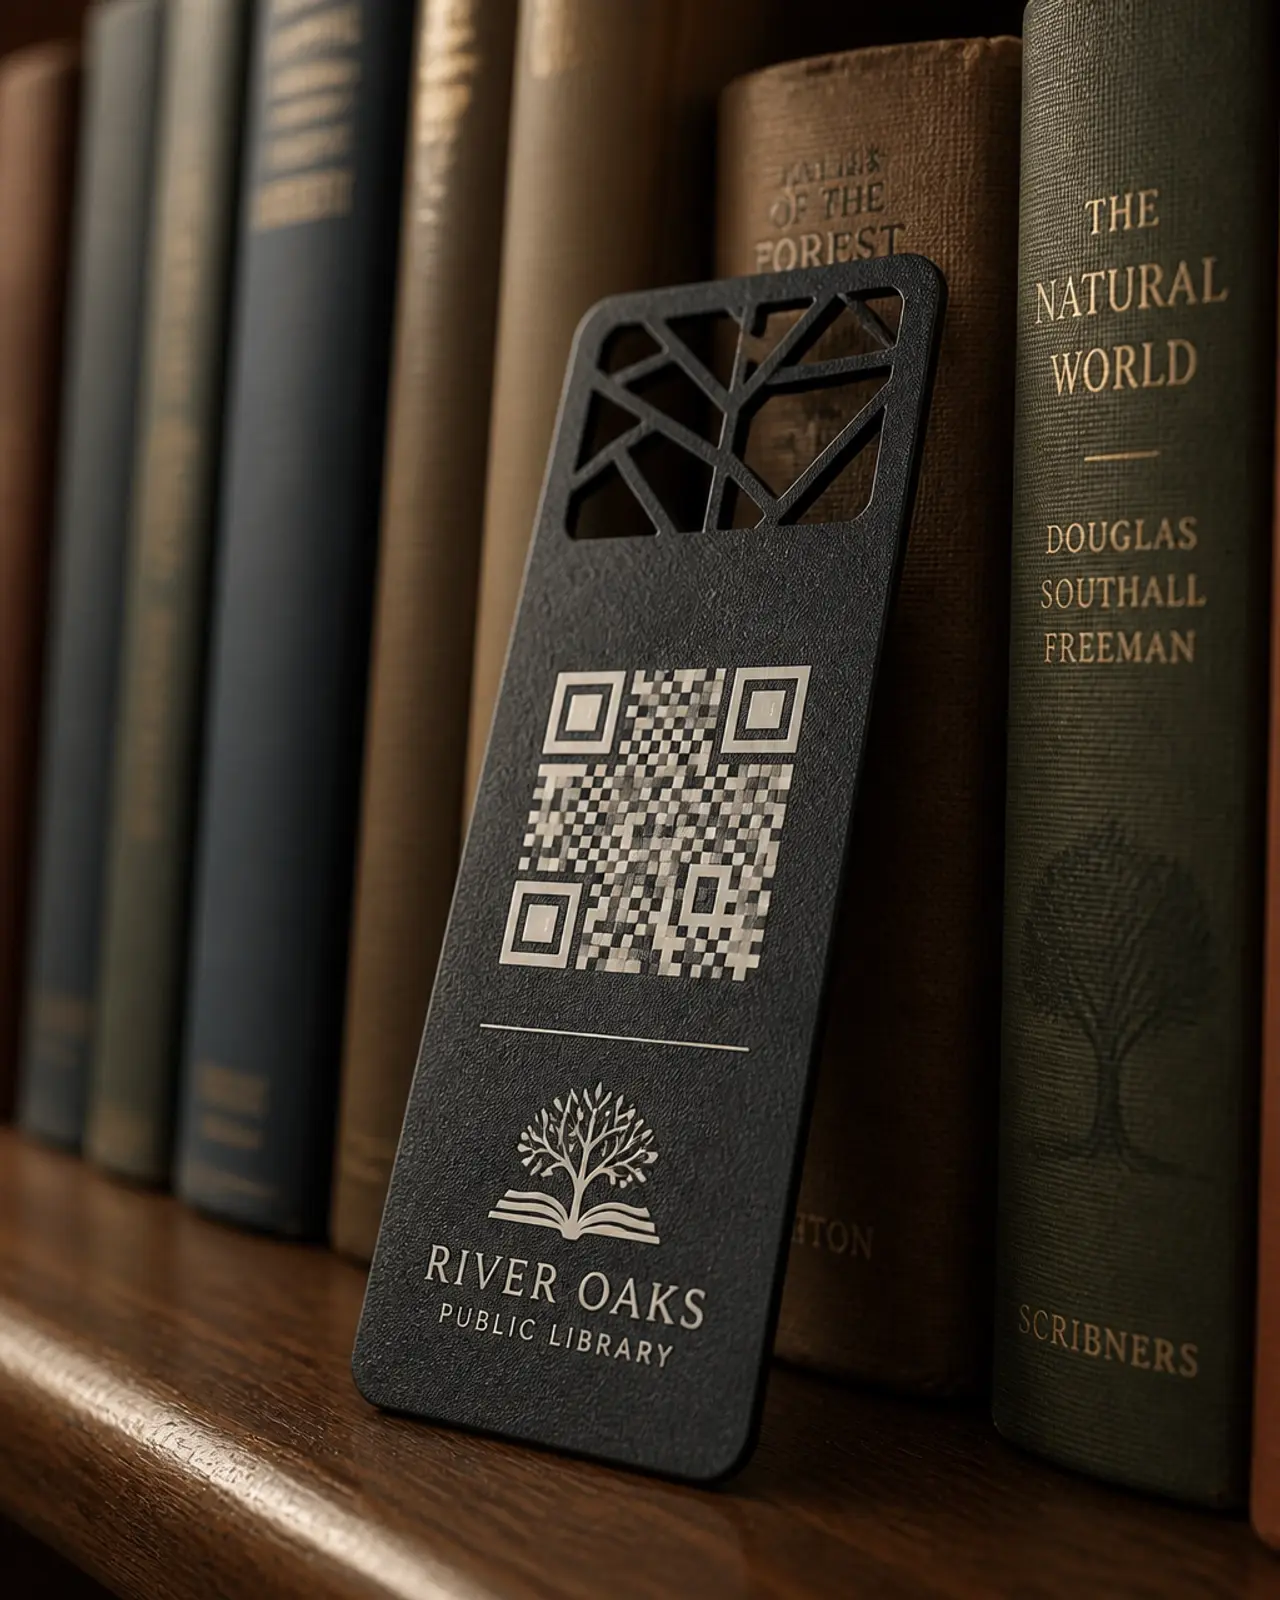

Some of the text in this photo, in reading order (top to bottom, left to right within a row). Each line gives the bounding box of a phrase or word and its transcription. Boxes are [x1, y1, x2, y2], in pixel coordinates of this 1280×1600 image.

[770, 181, 885, 230] OF THE
[1085, 188, 1160, 235] THE
[755, 223, 906, 273] FOREST
[1035, 256, 1229, 324] NATURAL
[1050, 339, 1198, 397] WORLD
[1046, 516, 1199, 554] DOUGLAS
[1040, 573, 1207, 609] SOUTHALL
[1044, 630, 1197, 664] FREEMAN
[424, 1244, 706, 1330] RIVER OAKS
[439, 1302, 674, 1368] PUBLIC LIBRARY
[1018, 1304, 1199, 1378] SCRIBNERS
